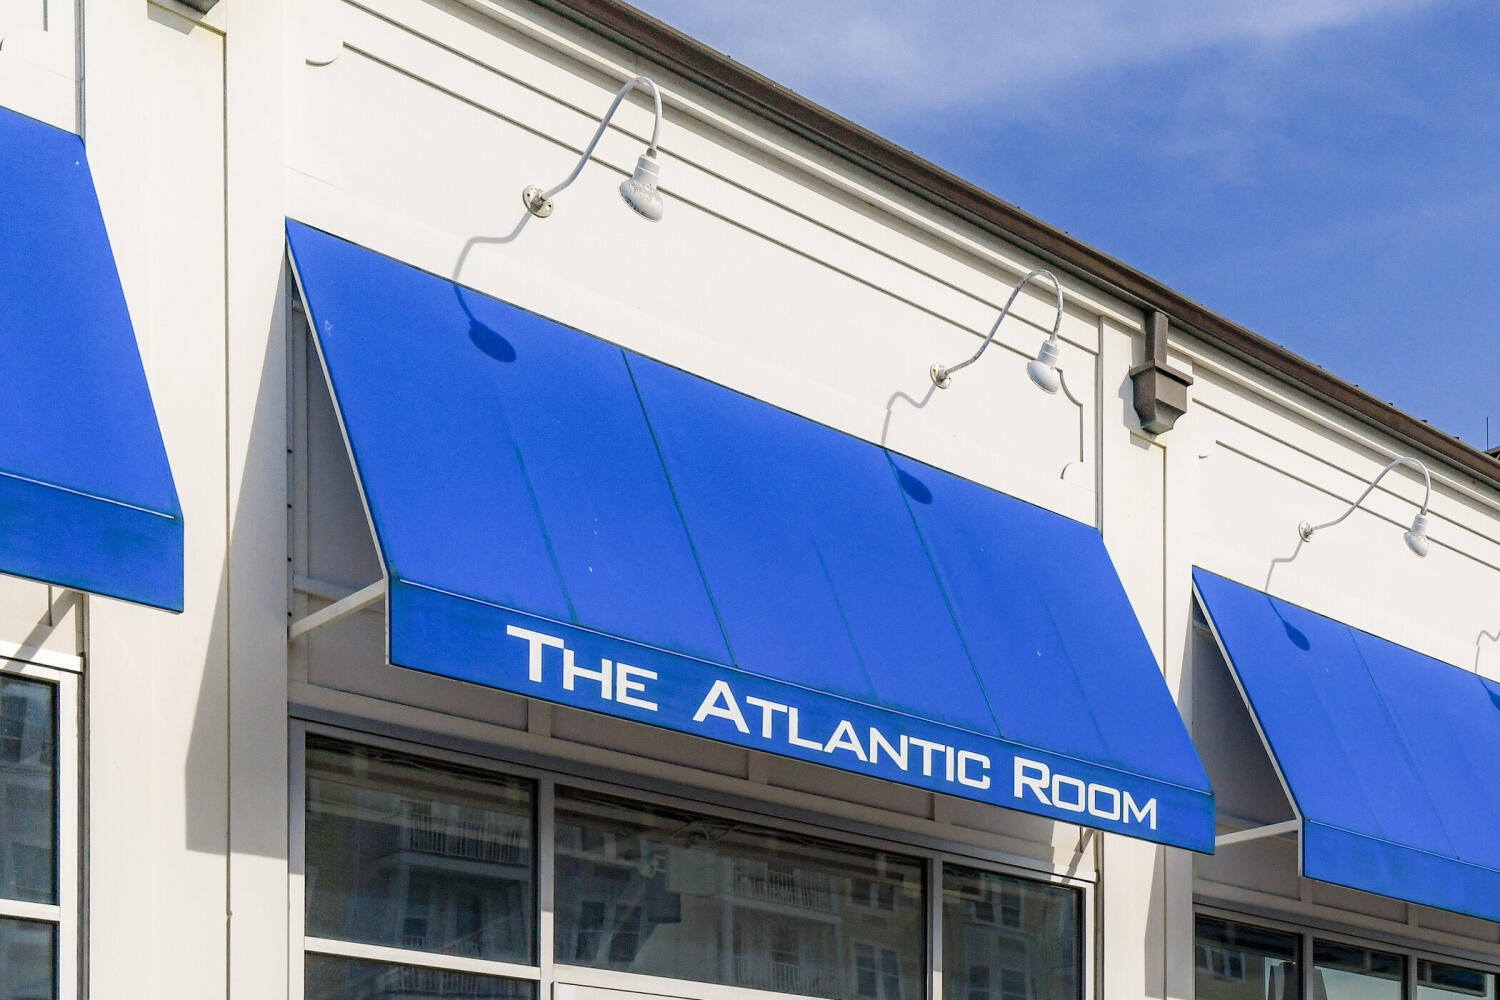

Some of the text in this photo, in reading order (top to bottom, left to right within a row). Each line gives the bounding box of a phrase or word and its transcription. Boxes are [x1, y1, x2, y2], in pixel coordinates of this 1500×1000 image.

[506, 624, 1157, 831] THE ATLANTIC ROOM
